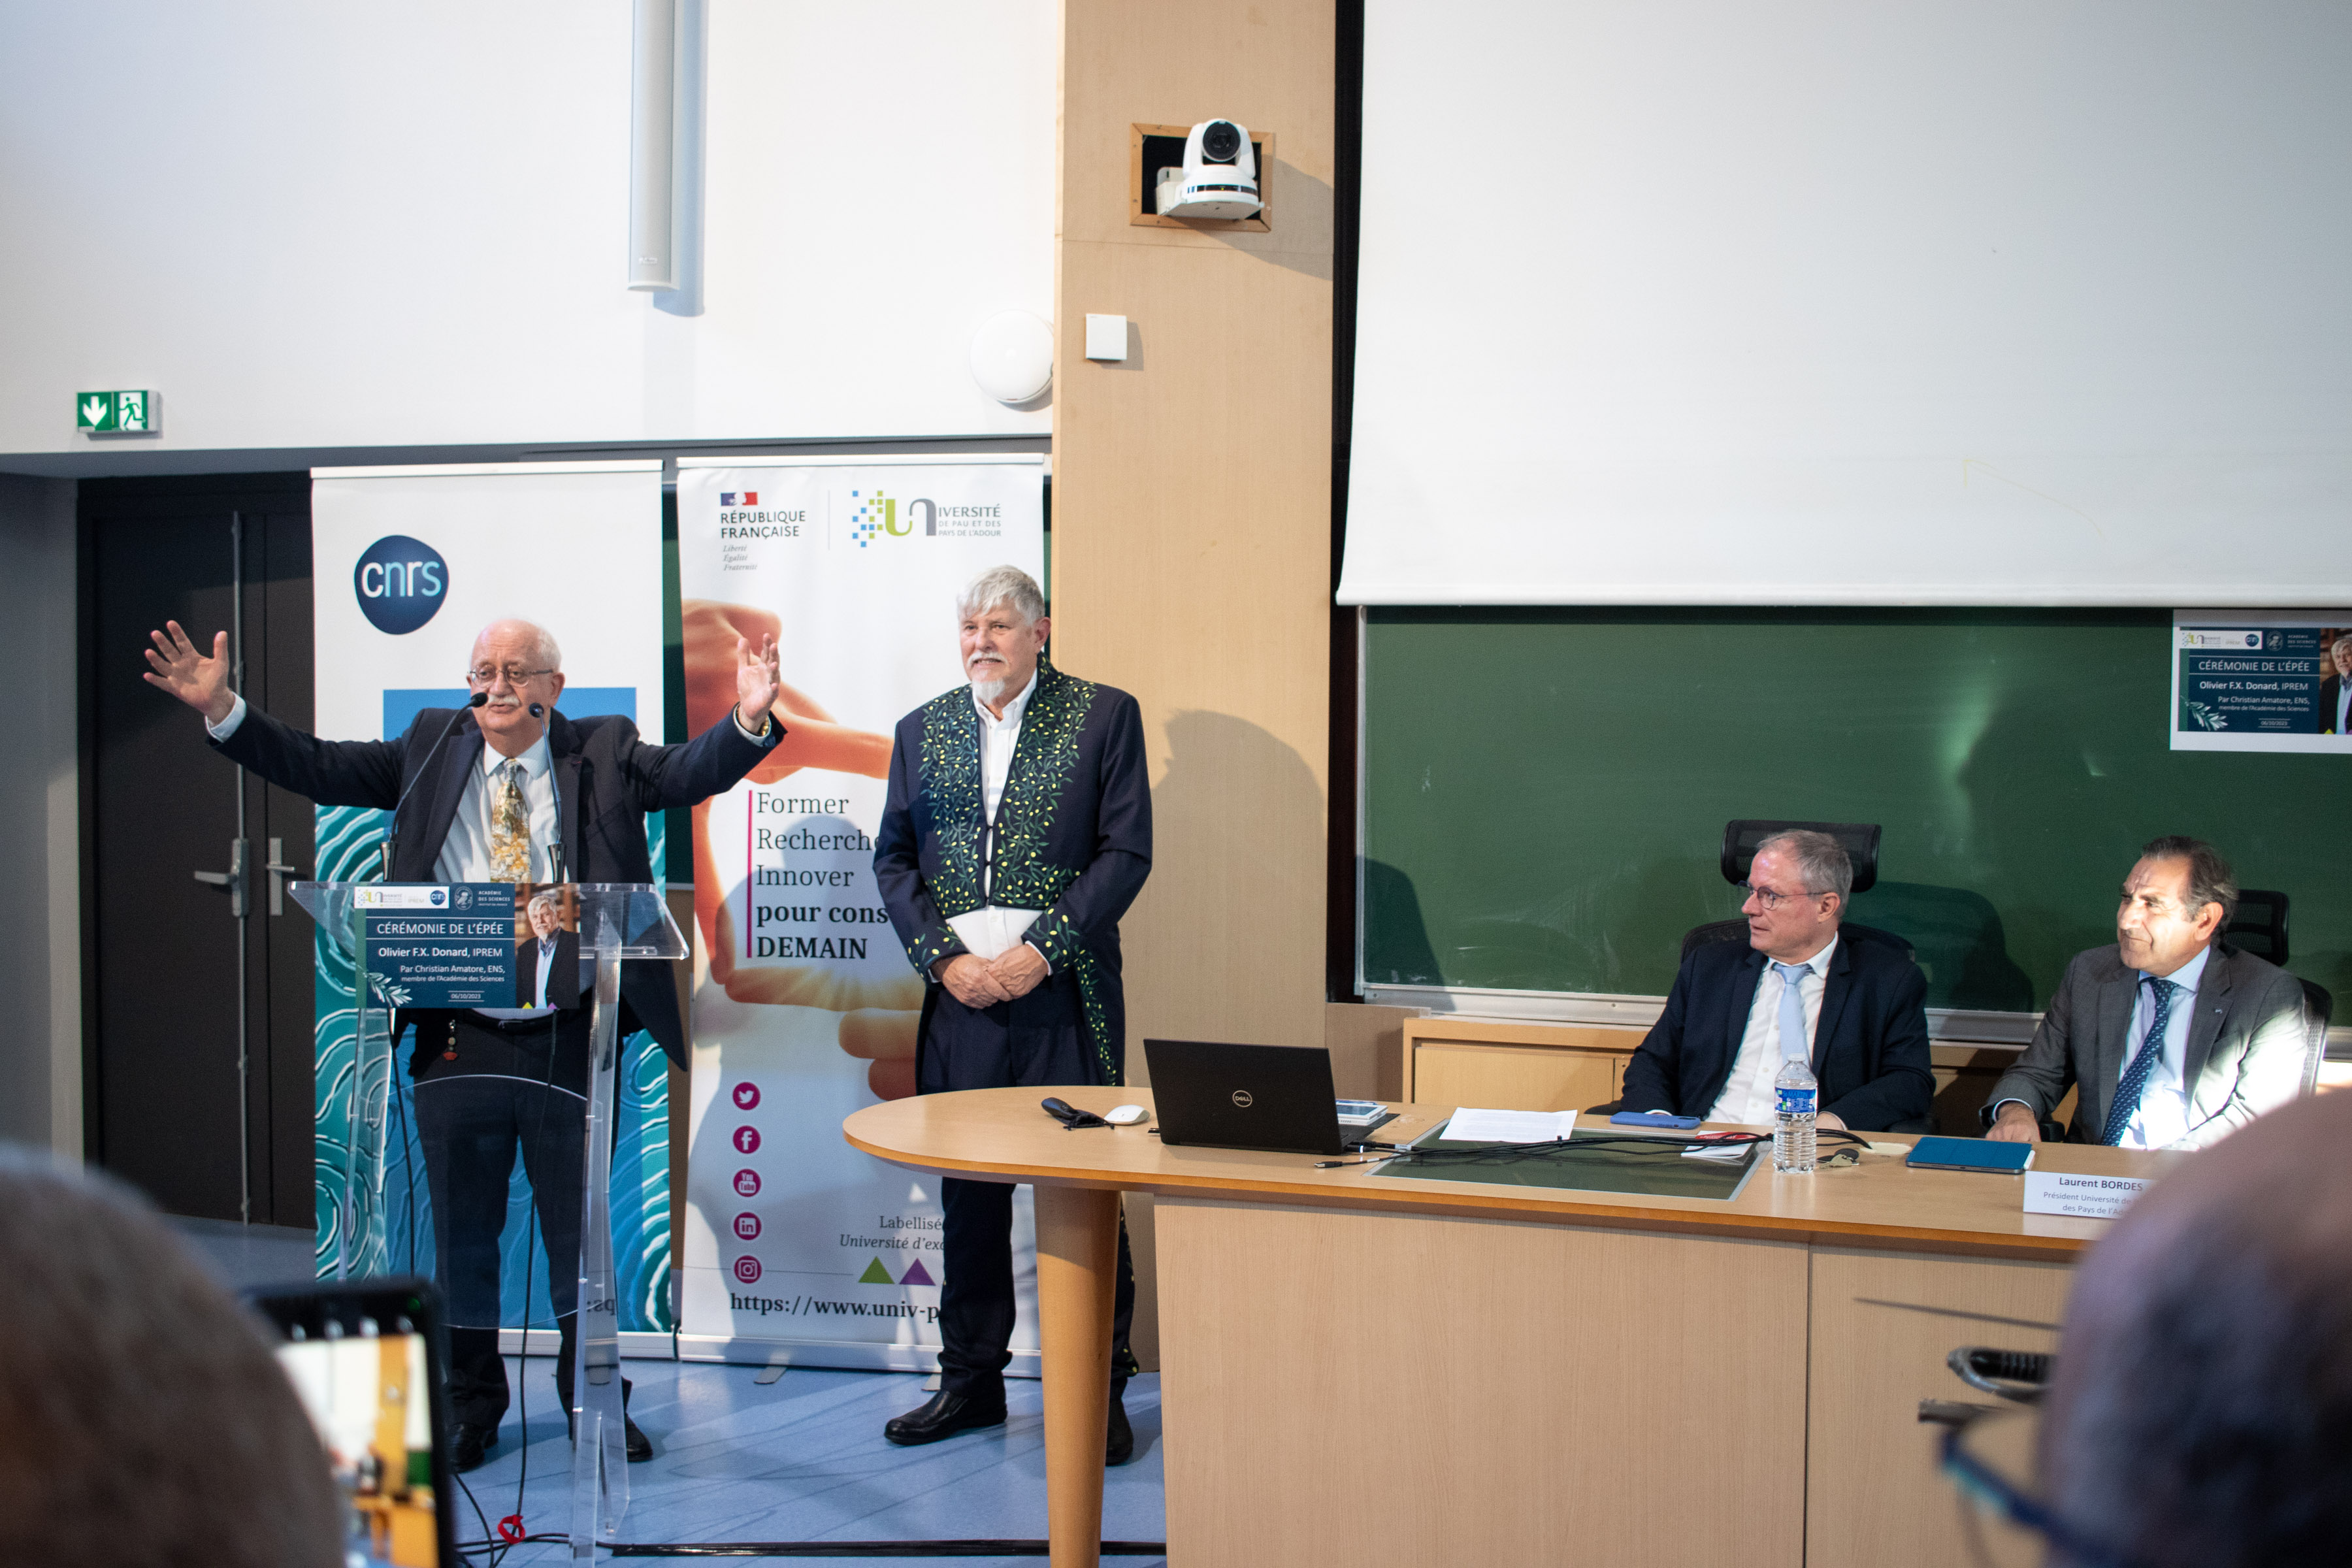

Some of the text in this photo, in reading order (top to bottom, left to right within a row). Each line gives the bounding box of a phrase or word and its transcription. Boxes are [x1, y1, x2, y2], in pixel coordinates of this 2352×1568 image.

[721, 510, 806, 524] RÉPUBLIQUE
[721, 526, 800, 540] FRANÇAISE
[361, 561, 442, 598] cnrs
[2198, 660, 2258, 670] CÉRÉMONIE
[2261, 662, 2274, 671] DE
[2246, 682, 2279, 691] Donard,
[757, 792, 849, 813] Former
[757, 864, 854, 886] Innover
[757, 905, 821, 927] pour
[377, 922, 503, 934] CÉRÉMONIE DE L'ÉPÉE
[378, 947, 502, 958] Olivier F.X. Donard, IPREM
[757, 937, 868, 958] DEMAIN
[451, 965, 485, 973] Amatore,
[2059, 1177, 2143, 1190] Laurent BORDES
[2044, 1192, 2078, 1200] Président
[2082, 1194, 2119, 1203] Université
[2078, 1205, 2095, 1214] Pays
[880, 1216, 941, 1230] Labellisé
[841, 1234, 909, 1249] Université
